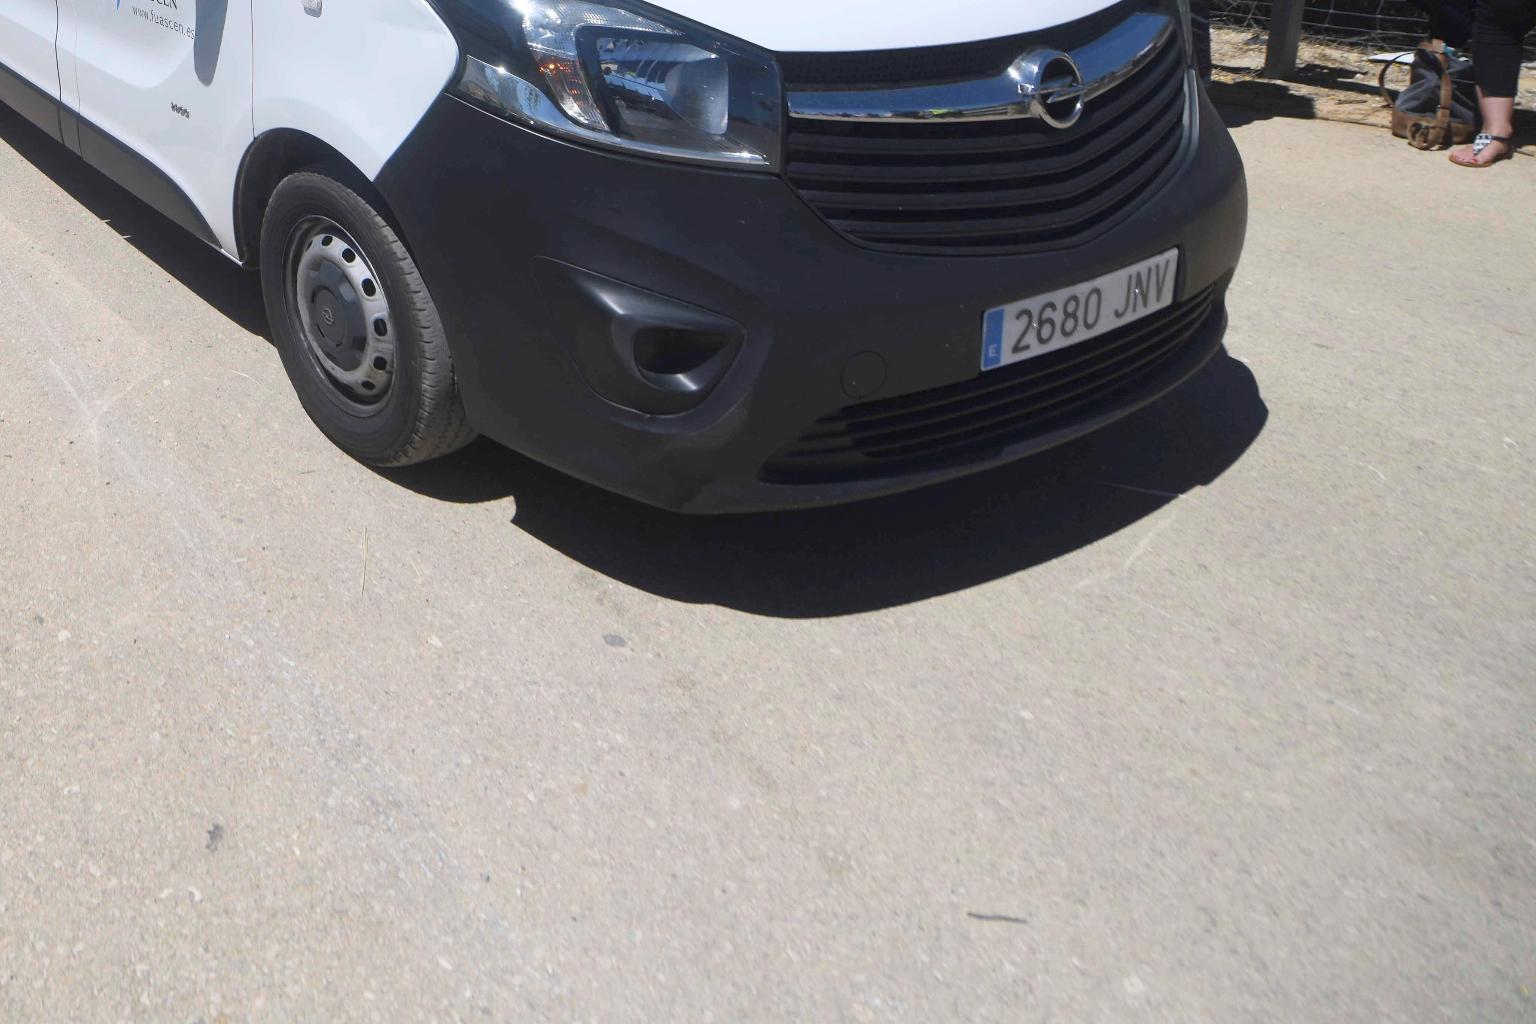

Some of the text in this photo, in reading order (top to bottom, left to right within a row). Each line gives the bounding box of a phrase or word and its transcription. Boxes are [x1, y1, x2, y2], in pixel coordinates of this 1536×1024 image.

[132, 6, 196, 40] www.fuascen.es
[1011, 259, 1170, 354] 2680 JNV
[988, 344, 998, 358] E
